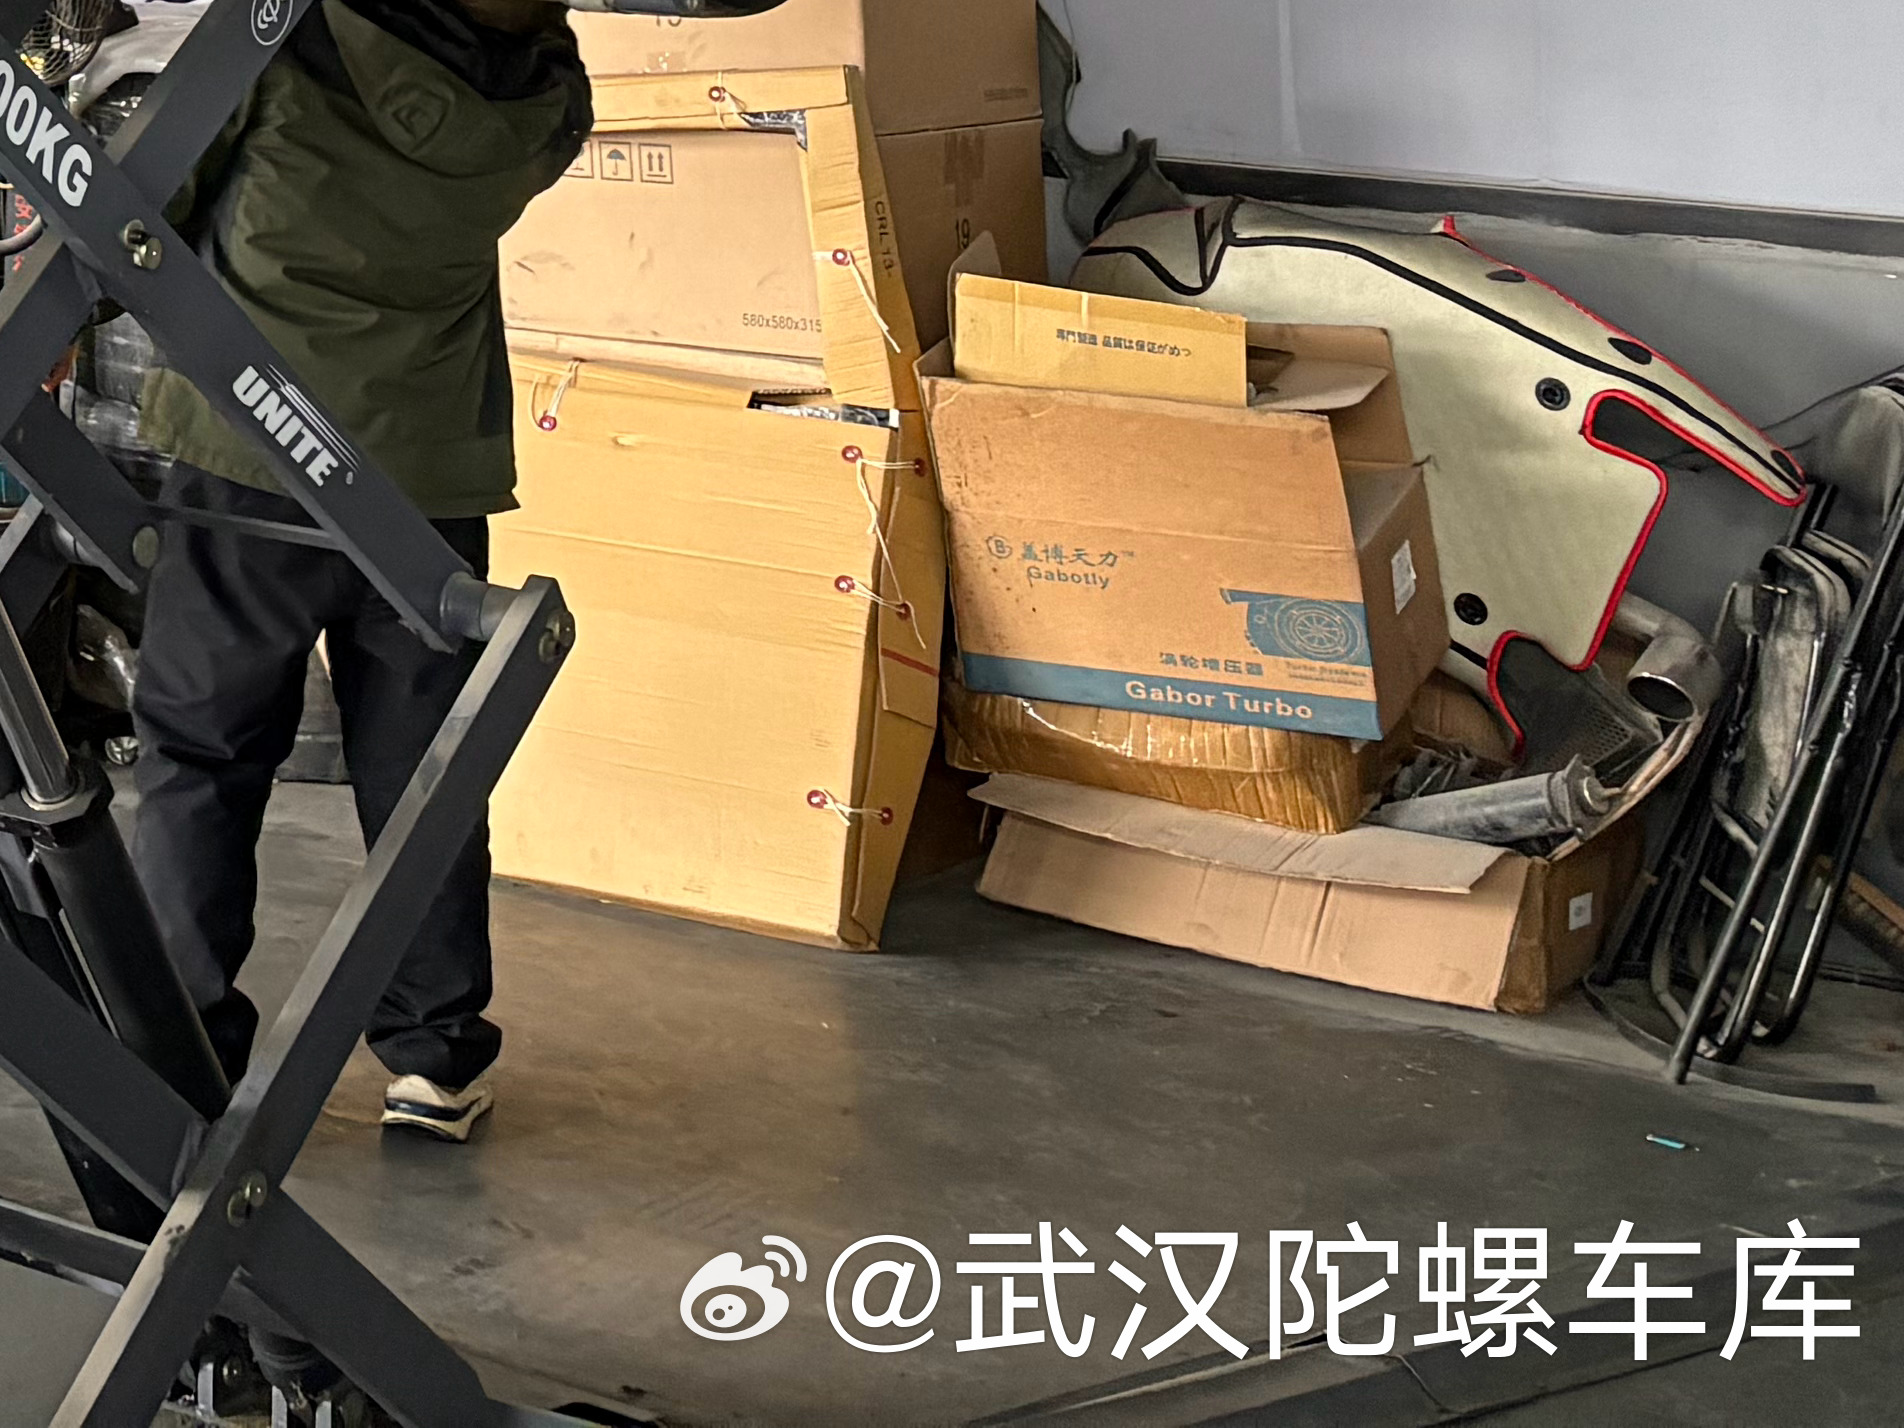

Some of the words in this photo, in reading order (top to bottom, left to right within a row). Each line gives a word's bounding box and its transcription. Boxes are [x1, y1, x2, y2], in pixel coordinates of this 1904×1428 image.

[232, 365, 339, 487] UNITE
[1125, 680, 1216, 709] Gabor
[1222, 691, 1313, 720] Turbo
